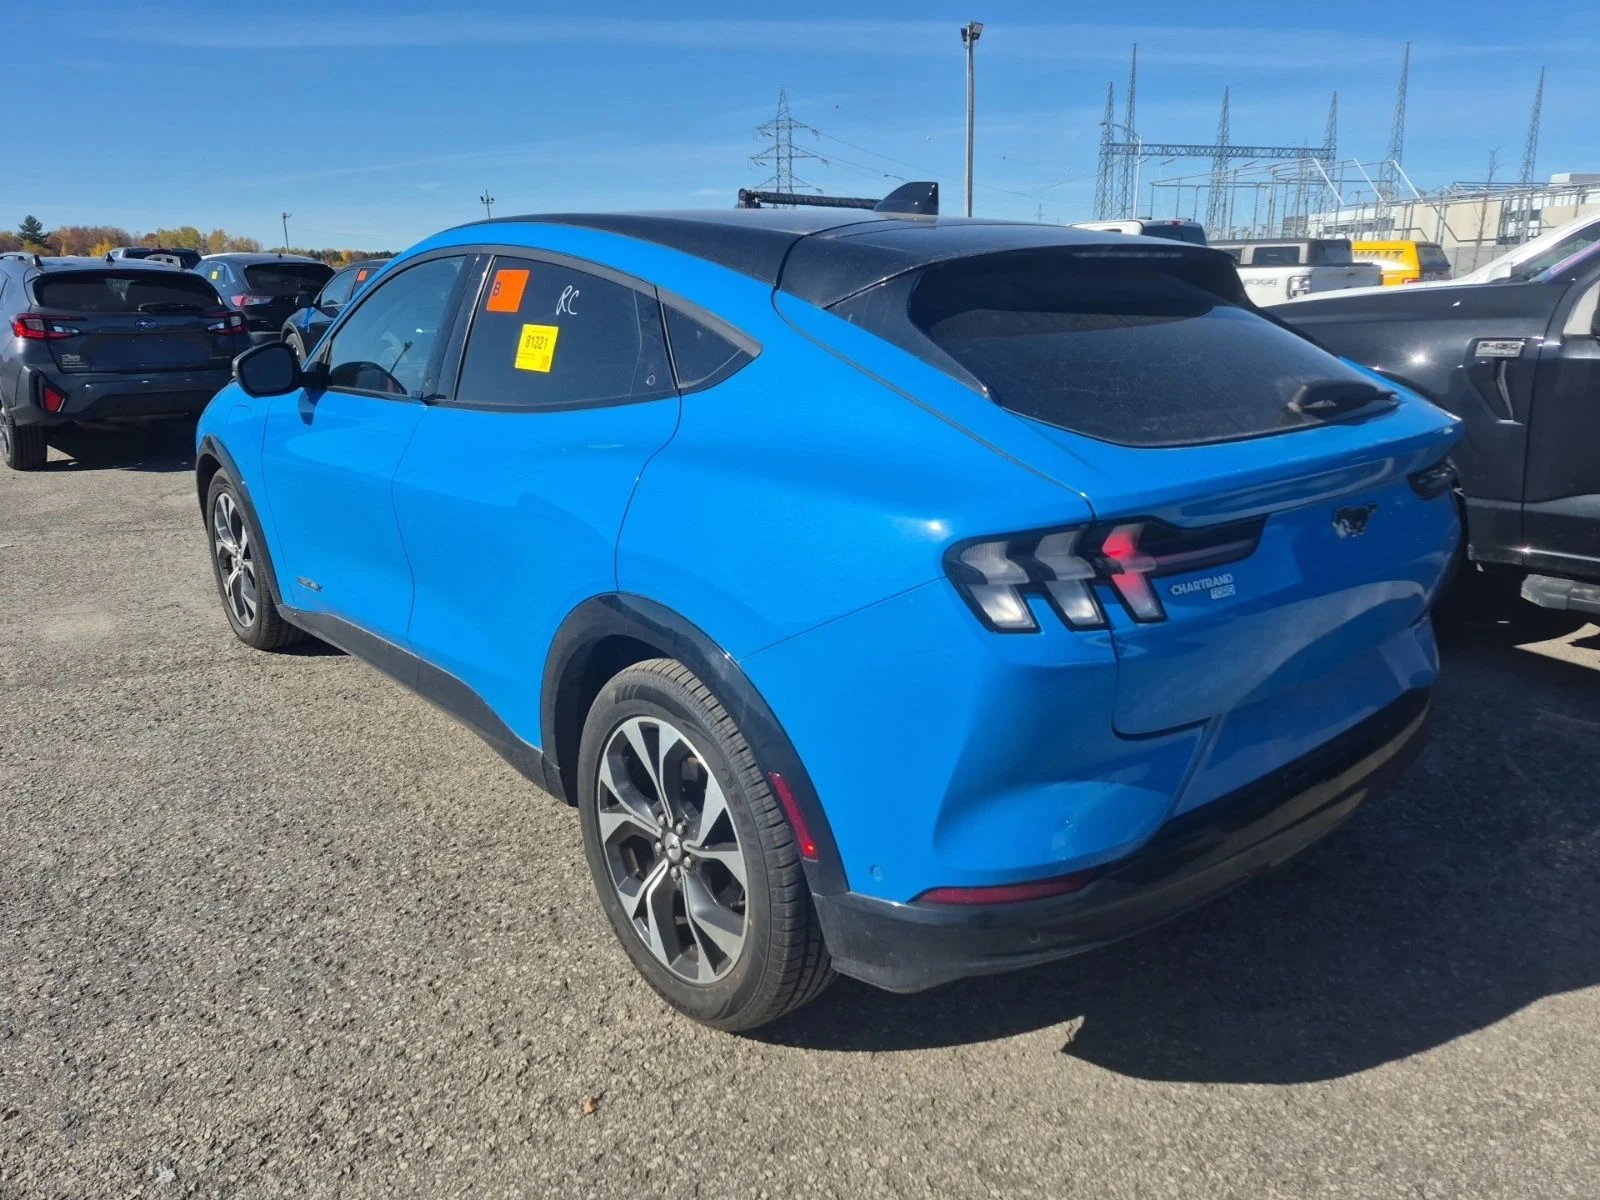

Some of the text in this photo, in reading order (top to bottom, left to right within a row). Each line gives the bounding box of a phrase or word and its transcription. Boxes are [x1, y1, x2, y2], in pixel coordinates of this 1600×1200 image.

[555, 284, 580, 316] RC
[525, 334, 549, 350] 81321
[1169, 573, 1234, 596] CHARTRAND
